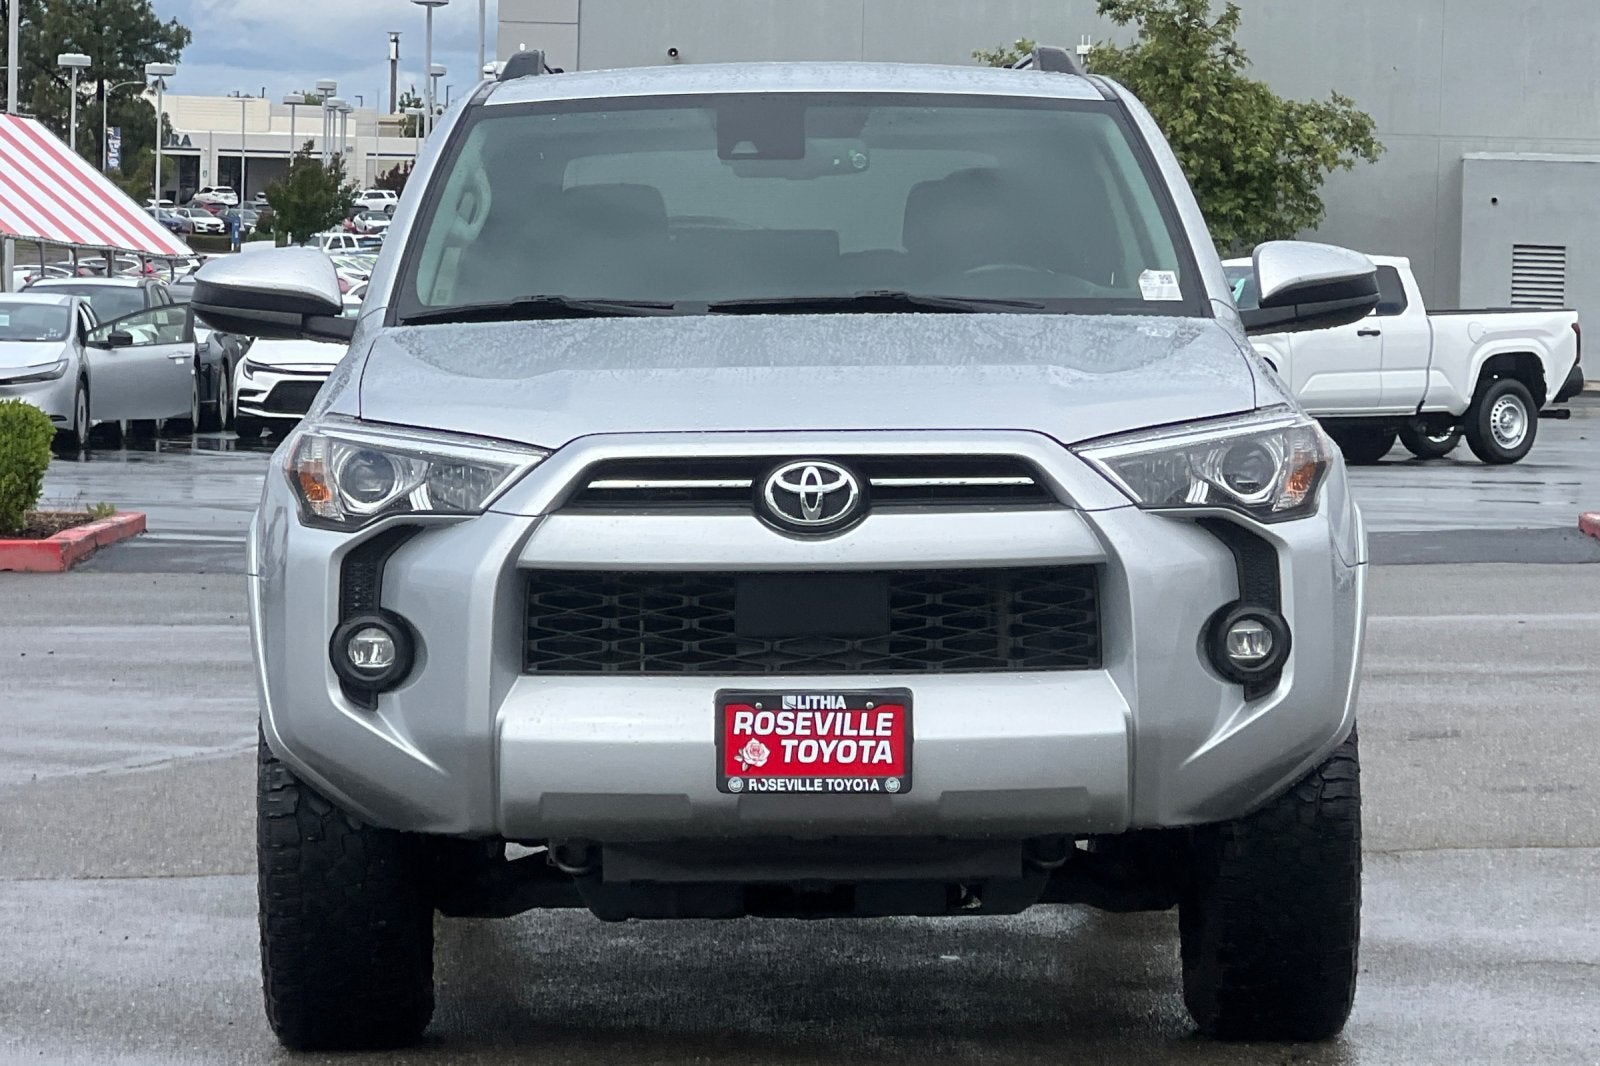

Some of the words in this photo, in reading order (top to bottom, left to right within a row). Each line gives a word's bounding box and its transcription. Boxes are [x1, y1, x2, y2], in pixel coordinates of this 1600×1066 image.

[797, 695, 846, 709] LITHIA
[733, 711, 894, 736] ROSEVILLE
[780, 739, 893, 763] TOYOTA
[748, 778, 823, 791] ROSEVILLE
[826, 778, 880, 791] TOYOTA
